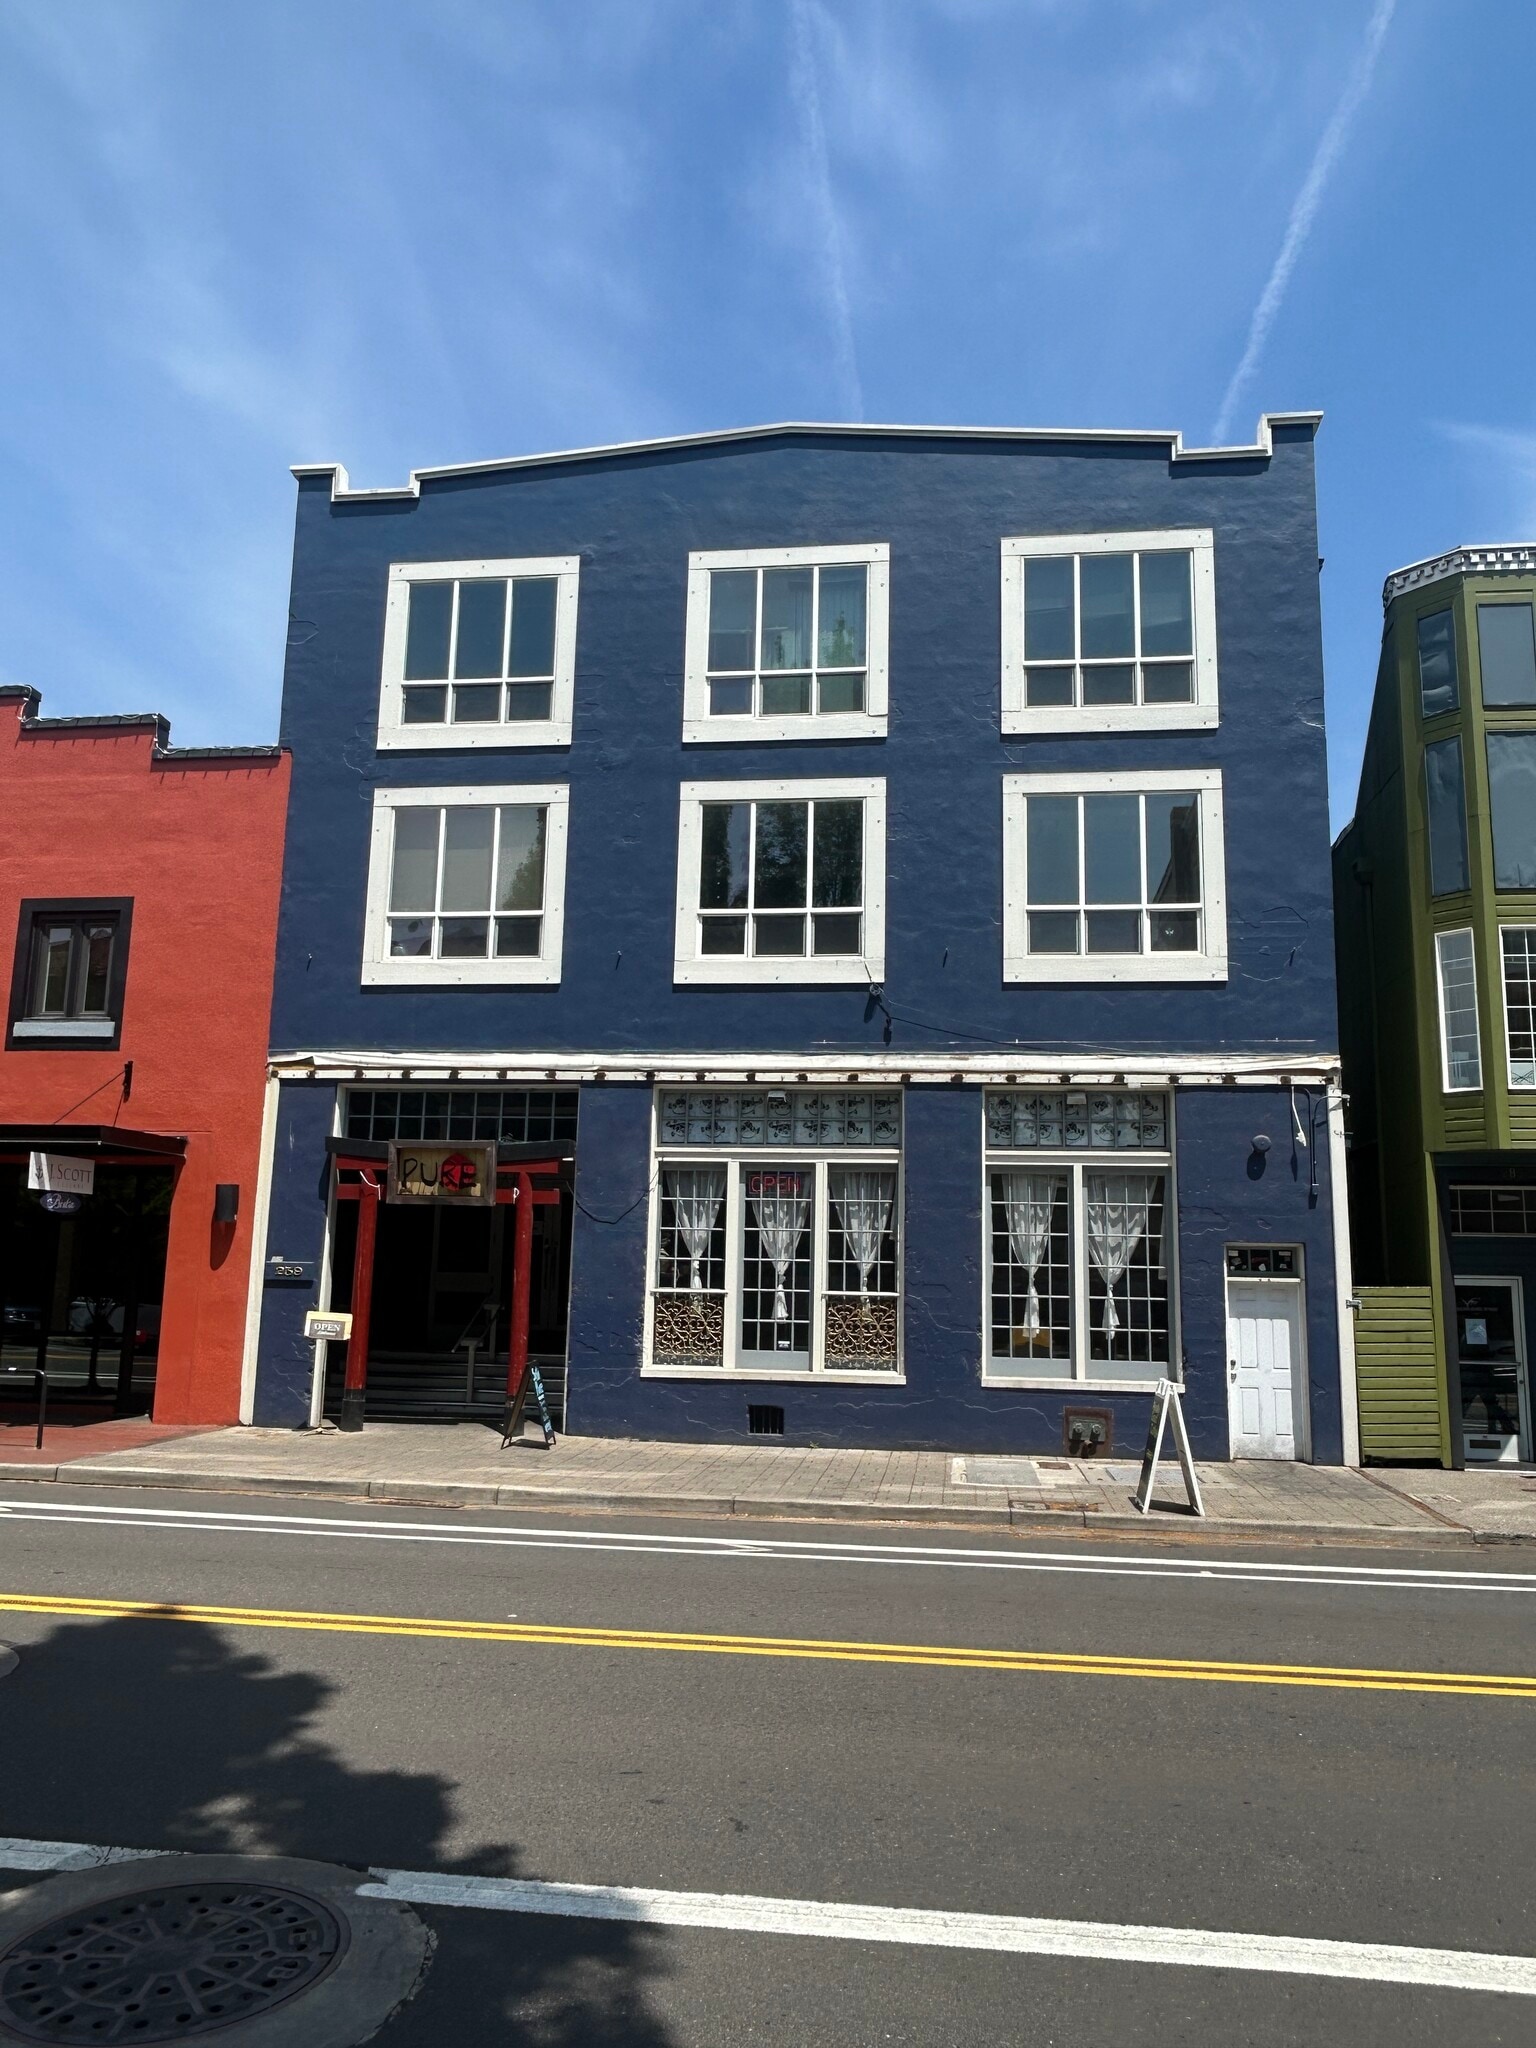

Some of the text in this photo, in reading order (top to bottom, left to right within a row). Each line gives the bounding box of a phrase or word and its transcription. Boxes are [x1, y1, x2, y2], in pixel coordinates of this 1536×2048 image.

[57, 1164, 92, 1184] SCOTT
[751, 1176, 799, 1192] OPEN
[314, 1322, 341, 1333] OPEN
